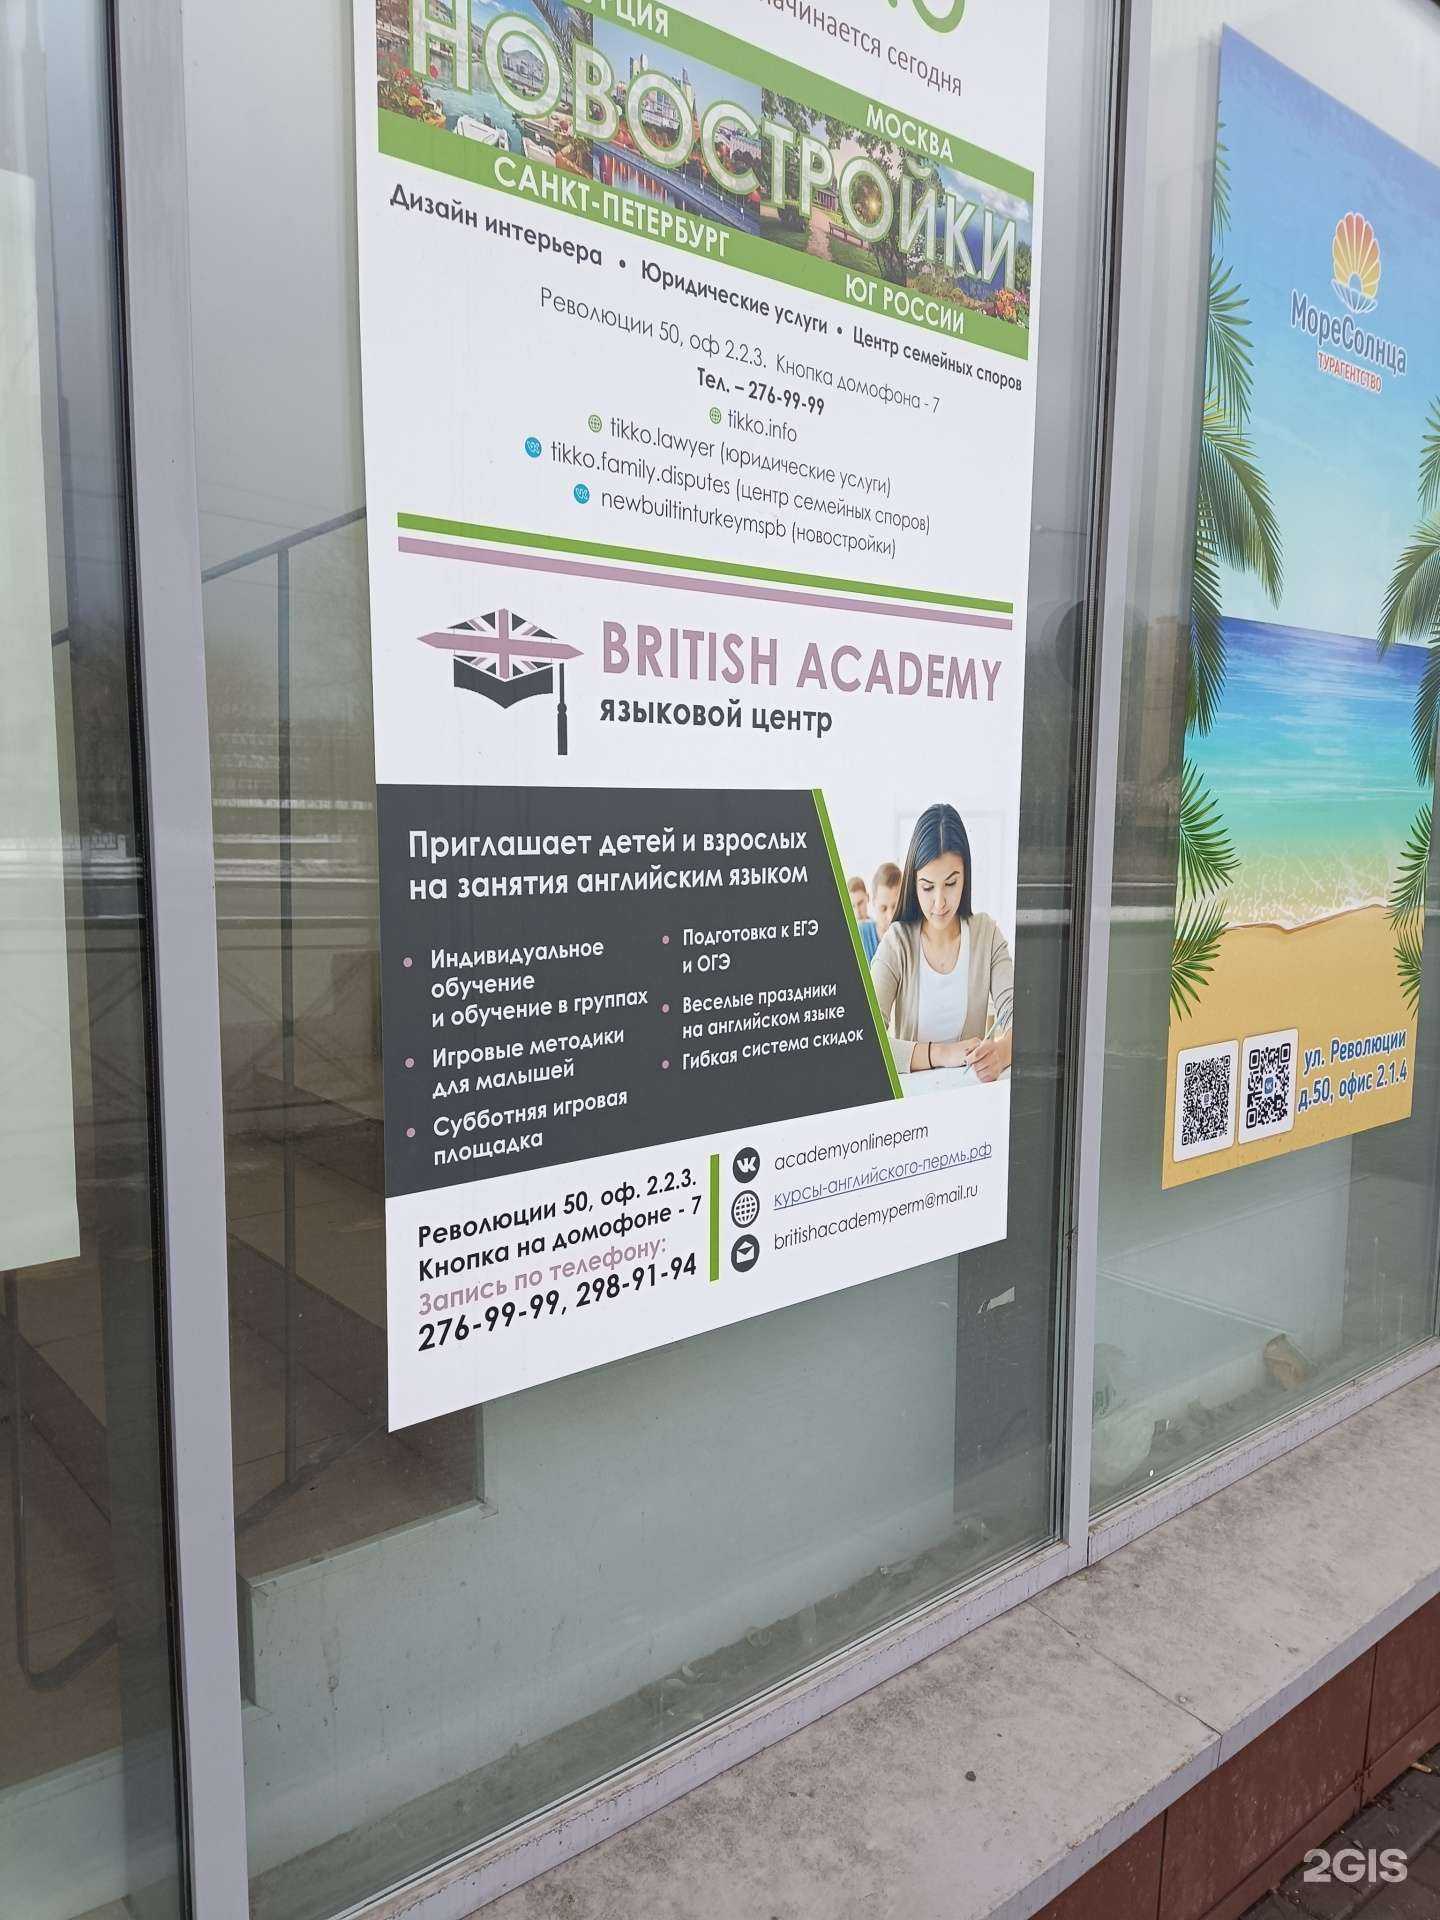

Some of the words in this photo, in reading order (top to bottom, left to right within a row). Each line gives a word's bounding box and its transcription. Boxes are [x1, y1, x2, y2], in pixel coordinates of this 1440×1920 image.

[585, 0, 669, 38] ЦИЯ
[760, 0, 881, 57] ачинается
[887, 46, 962, 97] сегодня
[407, 0, 1018, 288] НОВОСТРОЙКИ
[866, 104, 954, 162] МОСКВА
[493, 156, 730, 257] САНКТ-ПЕТЕРБУРГ
[389, 183, 478, 228] Дизайн
[485, 215, 602, 267] интерьера
[641, 260, 770, 317] Юридические
[774, 304, 828, 336] услуги
[853, 326, 899, 358] Центр
[902, 345, 975, 378] семейных
[976, 368, 1023, 392] споров
[845, 273, 877, 305] ЮГ
[883, 286, 965, 335] РОССИИ
[540, 286, 654, 338] Революции
[659, 321, 684, 348] 50,
[689, 333, 720, 359] оф
[725, 338, 768, 369] 2.2.3.
[776, 354, 833, 386] Кнопка
[837, 376, 921, 409] домофона
[932, 396, 941, 413] 7
[1291, 288, 1407, 376] МореСолнца
[697, 367, 731, 393] Тел.
[748, 380, 825, 416] 276-99-99
[1317, 351, 1382, 393] ТУРАГЕНТСТВО
[727, 409, 798, 442] tikko.info
[610, 417, 716, 459] tikko.lawyer
[720, 441, 836, 484] (юридические
[840, 471, 891, 499] услуги)
[551, 441, 731, 495] tikko.family.disputes
[736, 478, 790, 509] (центр
[793, 493, 871, 522] семейных
[875, 510, 931, 536] споров)
[601, 491, 787, 539] newbuiltinturkeymspb
[791, 521, 896, 560] (новостройки)
[602, 620, 779, 687] BRITISH
[796, 642, 1004, 702] ACADEMY
[599, 697, 743, 729] языковой
[752, 705, 834, 738] центр
[408, 829, 593, 861] Приглашает
[599, 826, 677, 858] детей
[682, 833, 696, 853] и
[703, 828, 808, 859] взрослых
[409, 878, 448, 900] на
[457, 871, 569, 896] занятия
[577, 863, 723, 894] английским
[729, 864, 809, 886] языком
[430, 939, 605, 970] Индивидуальное
[682, 924, 777, 947] Подготовка
[781, 926, 789, 940] к
[793, 919, 819, 938] ЕГЭ
[431, 972, 536, 1002] обучение
[682, 961, 693, 974] и
[696, 953, 731, 974] ОГЭ
[431, 1011, 445, 1029] и
[450, 998, 553, 1029] обучение
[558, 1001, 569, 1015] в
[574, 988, 648, 1017] группах
[682, 990, 753, 1014] Веселые
[758, 981, 838, 1008] праздники
[682, 1024, 703, 1040] на
[707, 1010, 800, 1037] английском
[804, 1005, 846, 1023] языке
[432, 1042, 524, 1072] Игровые
[529, 1027, 625, 1057] методики
[682, 1047, 738, 1071] Гибкая
[742, 1034, 809, 1060] система
[813, 1025, 864, 1050] скидок
[1303, 1049, 1325, 1075] ул.
[1330, 1029, 1407, 1064] Революции
[432, 1077, 470, 1100] для
[476, 1059, 575, 1090] малышей
[1298, 1076, 1334, 1112] д.50,
[1338, 1072, 1372, 1100] офис
[1377, 1059, 1408, 1089] 2.1.4
[432, 1102, 548, 1140] Субботняя
[553, 1088, 628, 1119] игровая
[433, 1130, 544, 1167] площадка
[774, 1125, 929, 1171] academyonlineperm
[773, 1141, 993, 1209] курсы-английского-пермь.рф
[418, 1201, 557, 1248] Революции
[563, 1191, 594, 1214] 50,
[600, 1181, 641, 1206] оф.
[646, 1167, 697, 1197] 2.2.3.
[774, 1184, 979, 1250] britishacademyperm@mail.ru
[418, 1243, 510, 1282] Кнопка
[517, 1236, 546, 1258] на
[551, 1205, 672, 1251] домофоне
[691, 1195, 702, 1215] 7
[418, 1280, 508, 1316] Запись
[515, 1269, 543, 1291] по
[549, 1237, 667, 1281] телефону:
[418, 1289, 567, 1352] 276-99-99,
[576, 1252, 698, 1308] 298-91-94
